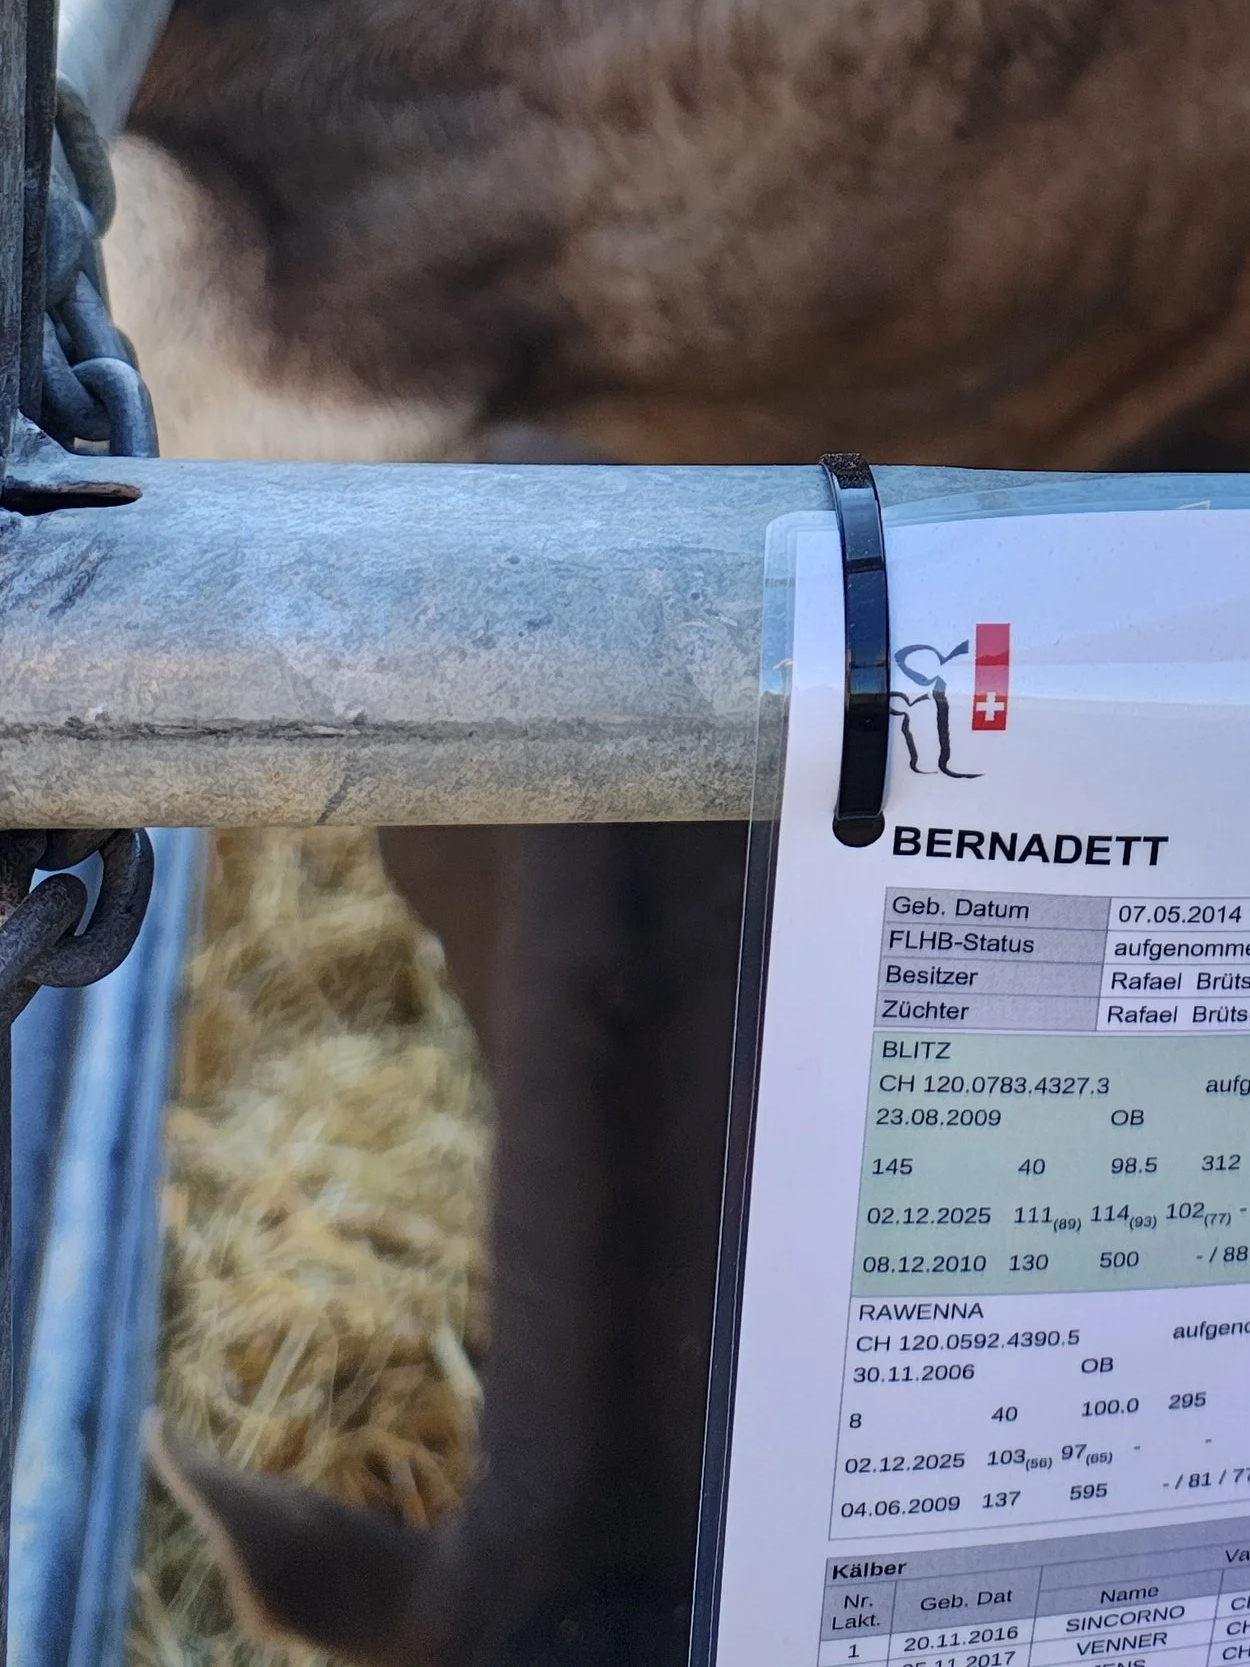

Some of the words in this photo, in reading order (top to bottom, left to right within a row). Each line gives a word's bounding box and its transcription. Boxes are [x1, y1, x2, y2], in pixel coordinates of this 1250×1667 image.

[893, 826, 1169, 866] BERNADETT
[893, 896, 945, 916] Geb.
[956, 899, 1029, 919] Datum
[1119, 905, 1241, 923] 07.05.2014
[889, 931, 1034, 954] FLHB-Status
[886, 965, 978, 986] Besitzer
[1112, 972, 1182, 990] Rafael
[882, 1000, 968, 1020] Züchter
[1108, 1005, 1177, 1024] Rafael
[882, 1040, 951, 1059] BLITZ
[879, 1075, 915, 1094] CH
[923, 1075, 1110, 1095] 120.0783.4327.3
[876, 1108, 1001, 1127] 23.08.2009
[1111, 1109, 1145, 1126] OB
[872, 1158, 913, 1175] 145
[1018, 1158, 1045, 1175] 40
[1111, 1157, 1157, 1175] 98.5
[1201, 1154, 1241, 1171] 312
[867, 1206, 990, 1225] 02.12.2025
[863, 1254, 986, 1273] 08.12.2010
[1009, 1254, 1048, 1271] 130
[1100, 1251, 1139, 1269] 500
[859, 1303, 984, 1321] RAWENNA
[857, 1334, 891, 1353] CH
[899, 1330, 1080, 1351] 120.0592.4390.5
[853, 1363, 975, 1383] 30.11.2006
[1081, 1357, 1114, 1374] OB
[1081, 1397, 1139, 1417] 100.0
[1168, 1392, 1207, 1410] 295
[849, 1413, 862, 1429] 8
[991, 1405, 1018, 1423] 40
[845, 1453, 966, 1474] 02.12.2025
[982, 1491, 1021, 1509] 137
[1070, 1483, 1108, 1501] 595
[841, 1496, 961, 1518] 04.06.2009
[832, 1559, 907, 1581] Kälber
[844, 1594, 874, 1610] Nr.
[920, 1594, 969, 1612] Geb.
[977, 1589, 1013, 1607] Dat
[1100, 1584, 1159, 1604] Name
[831, 1613, 881, 1631] Lakt.
[1066, 1606, 1185, 1633] SINCORNO
[903, 1627, 1019, 1652] 20.11.2016
[1076, 1633, 1168, 1655] VENNER
[847, 1644, 859, 1659] 1
